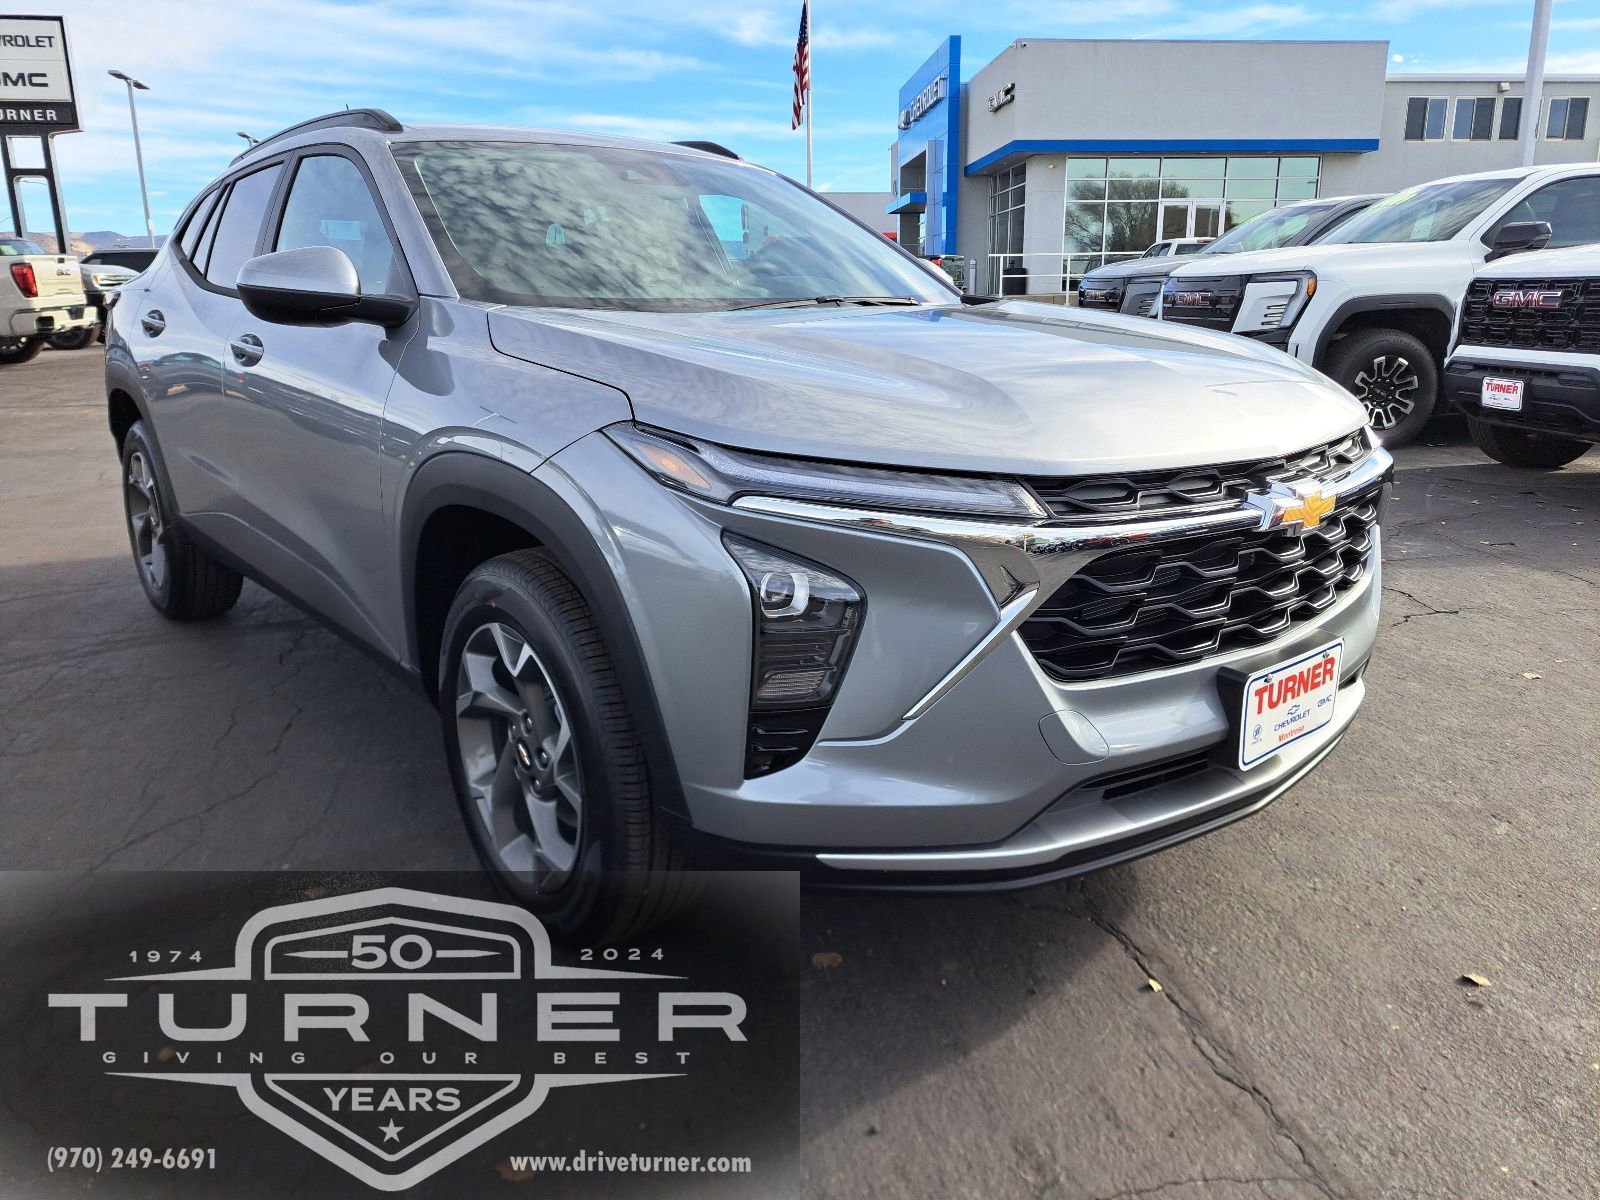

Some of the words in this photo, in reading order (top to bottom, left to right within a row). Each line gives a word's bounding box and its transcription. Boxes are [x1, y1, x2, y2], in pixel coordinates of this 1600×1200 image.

[0, 34, 55, 48] ROLET
[0, 72, 48, 87] MC
[909, 74, 948, 122] CHEVROLET
[1176, 292, 1211, 306] GMC
[1493, 290, 1562, 309] GMC
[1486, 382, 1519, 395] TURNER
[1254, 656, 1336, 715] TURNER
[1317, 694, 1333, 708] GMC
[1273, 709, 1311, 732] CHEVROLET
[1278, 725, 1305, 742] Montrose
